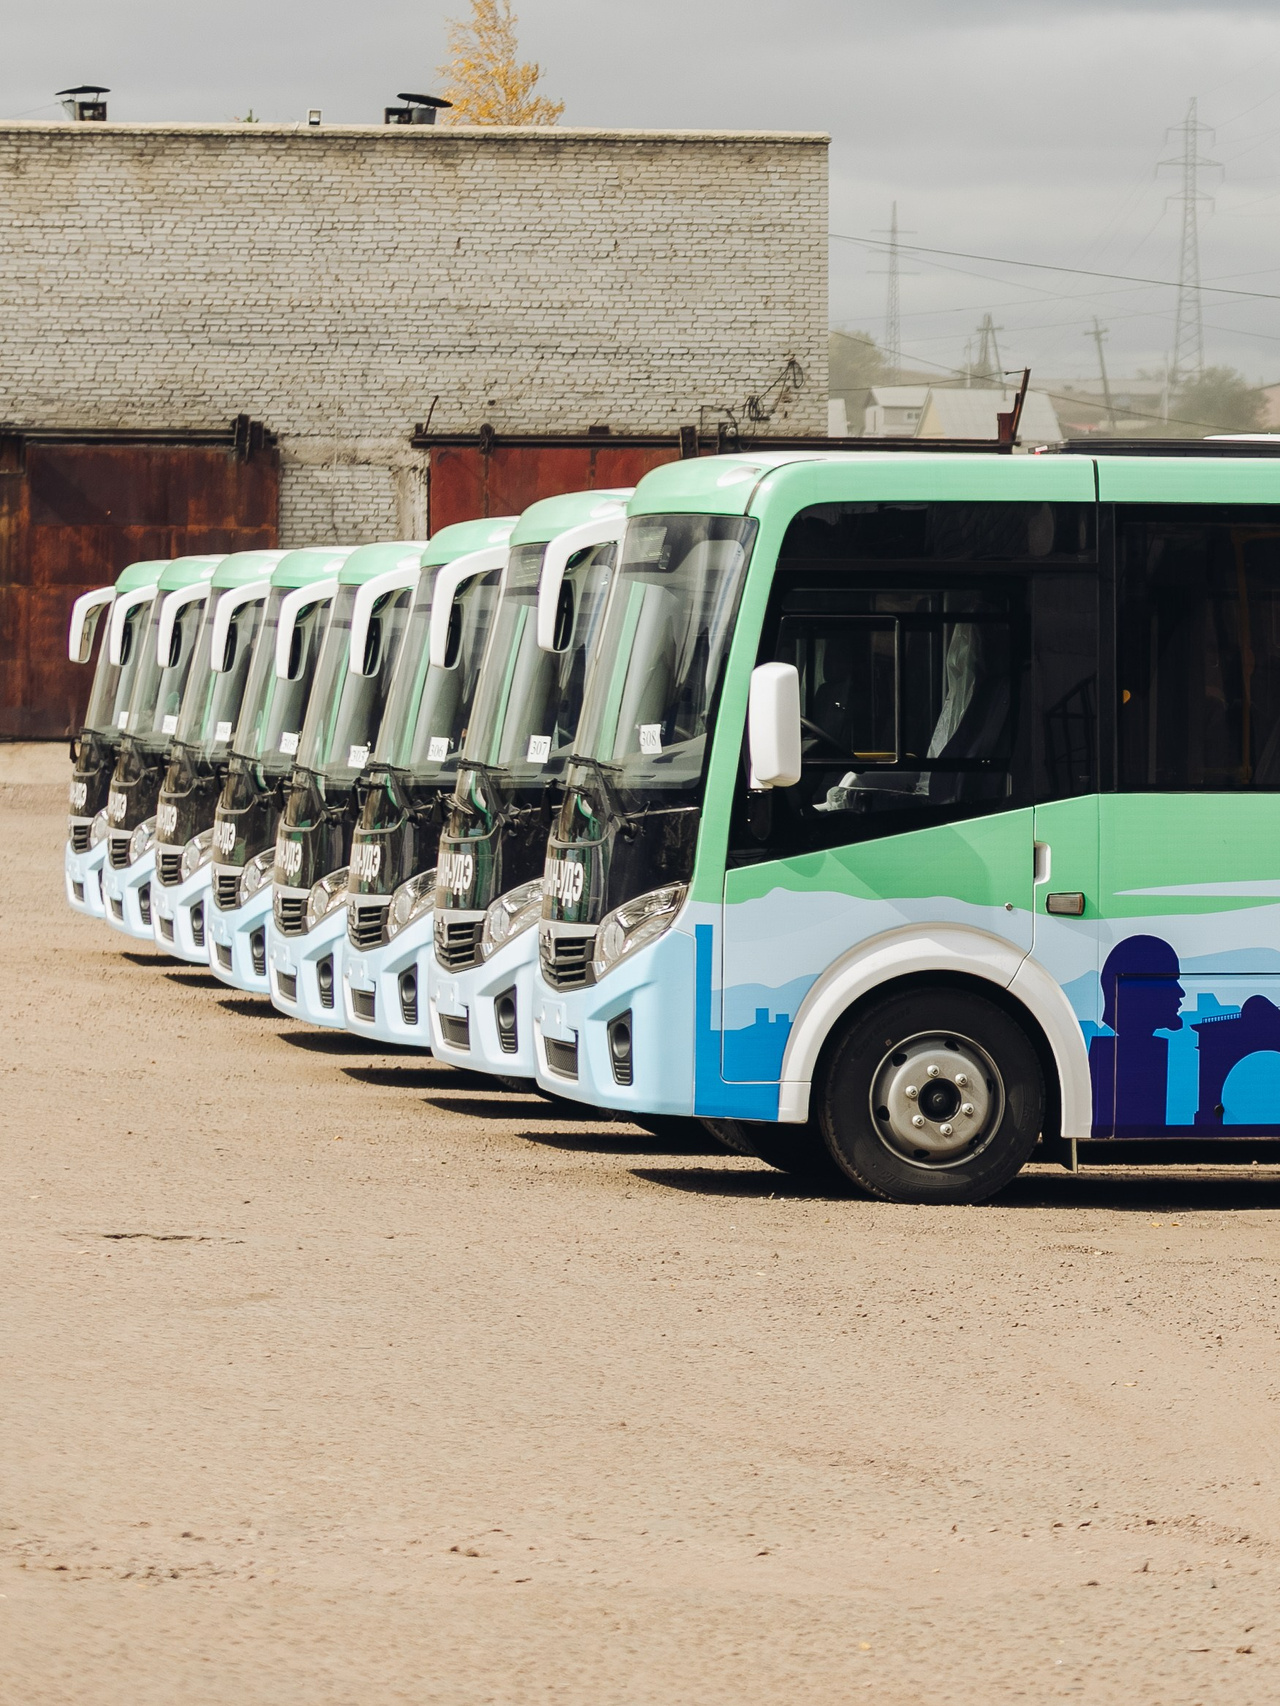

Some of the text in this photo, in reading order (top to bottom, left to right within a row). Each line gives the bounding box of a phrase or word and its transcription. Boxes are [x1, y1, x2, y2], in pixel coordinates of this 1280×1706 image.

[640, 730, 657, 747] 308
[428, 744, 444, 758] 306
[530, 740, 548, 755] 307
